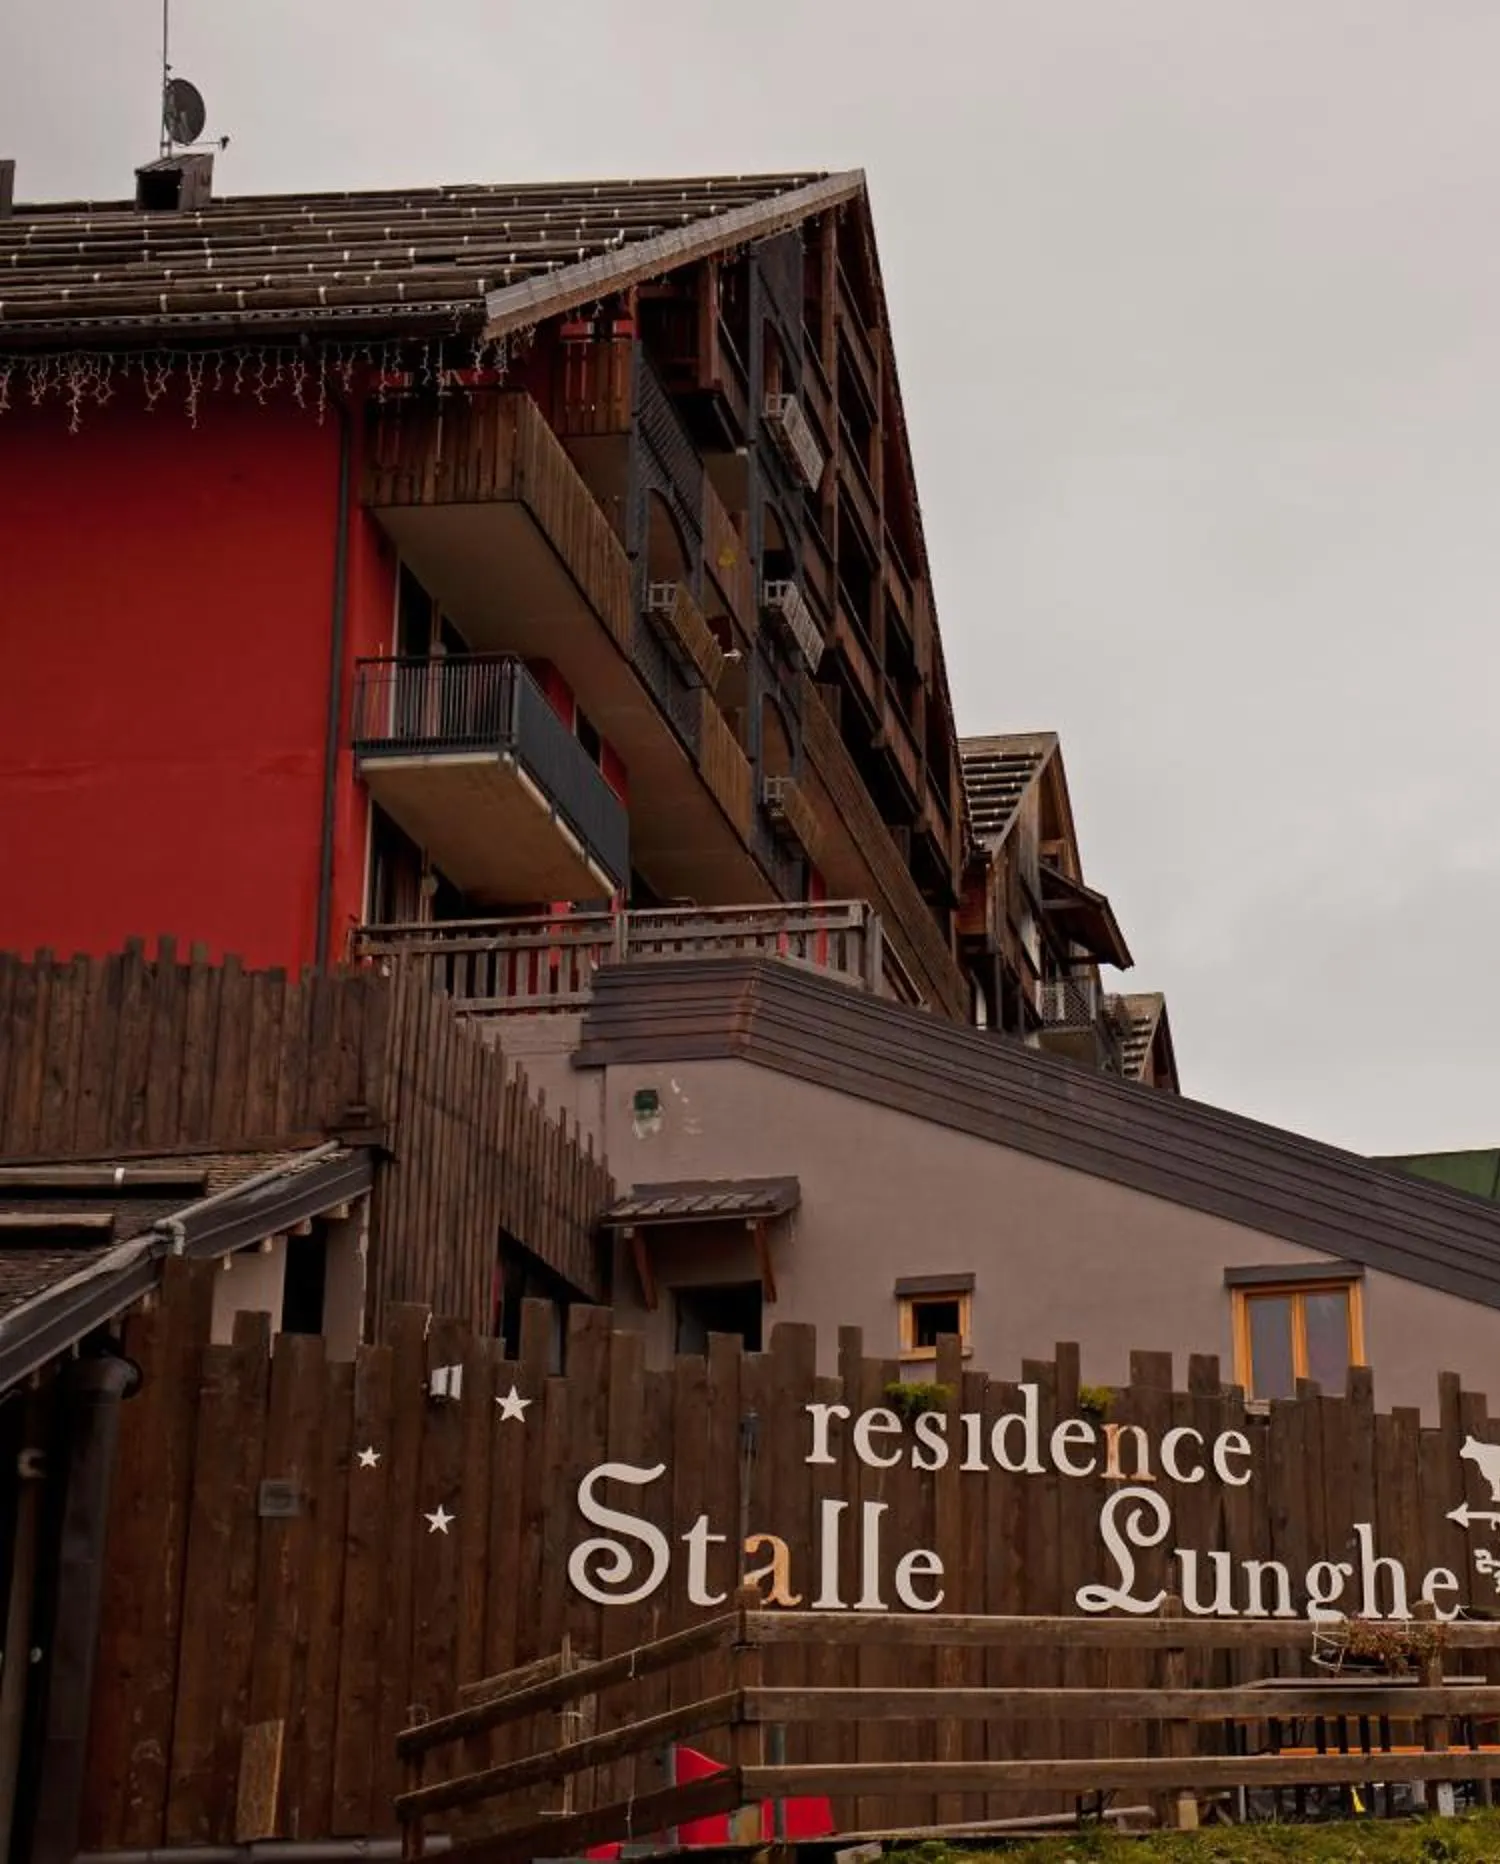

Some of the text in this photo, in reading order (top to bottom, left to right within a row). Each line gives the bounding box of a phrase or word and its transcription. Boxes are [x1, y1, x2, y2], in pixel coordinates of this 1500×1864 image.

[805, 1384, 1253, 1486] residence
[568, 1463, 1461, 1622] Stalle Lunghe
